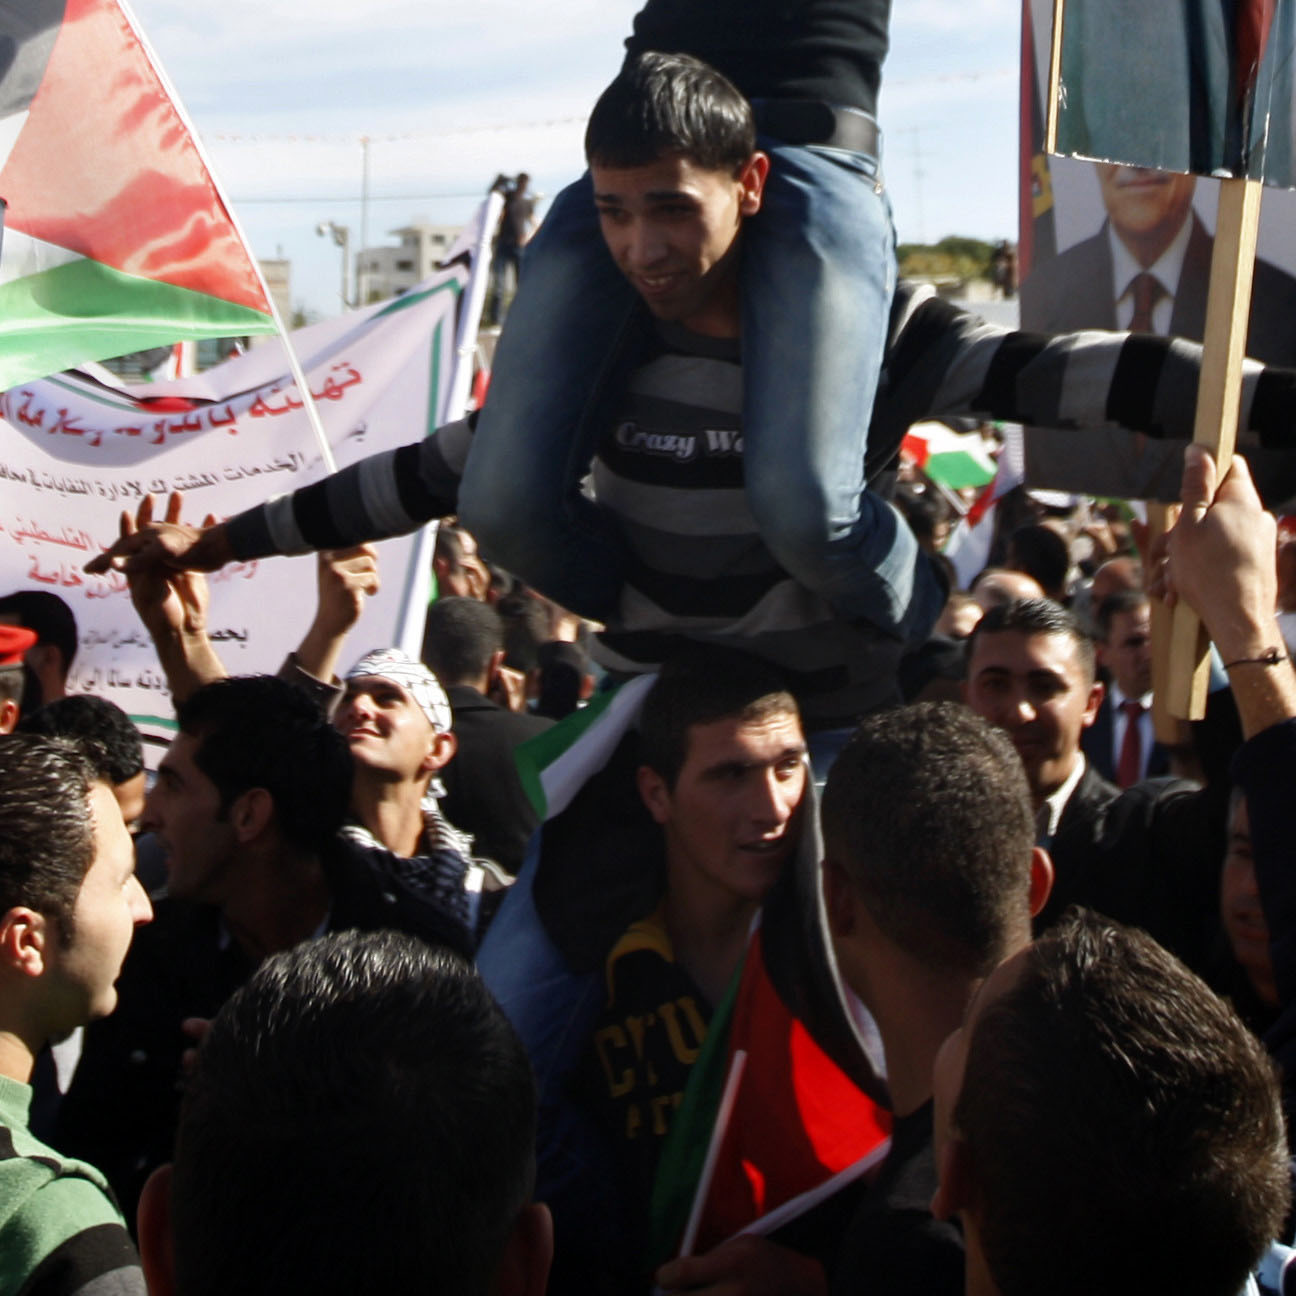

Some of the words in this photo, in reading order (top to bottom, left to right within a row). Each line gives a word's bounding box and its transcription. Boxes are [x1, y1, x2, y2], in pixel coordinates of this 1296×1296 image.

[616, 421, 696, 459] Crazy
[223, 451, 304, 481] الخدمات
[8, 515, 93, 550] الفلسطيني
[28, 554, 83, 587] خاصة
